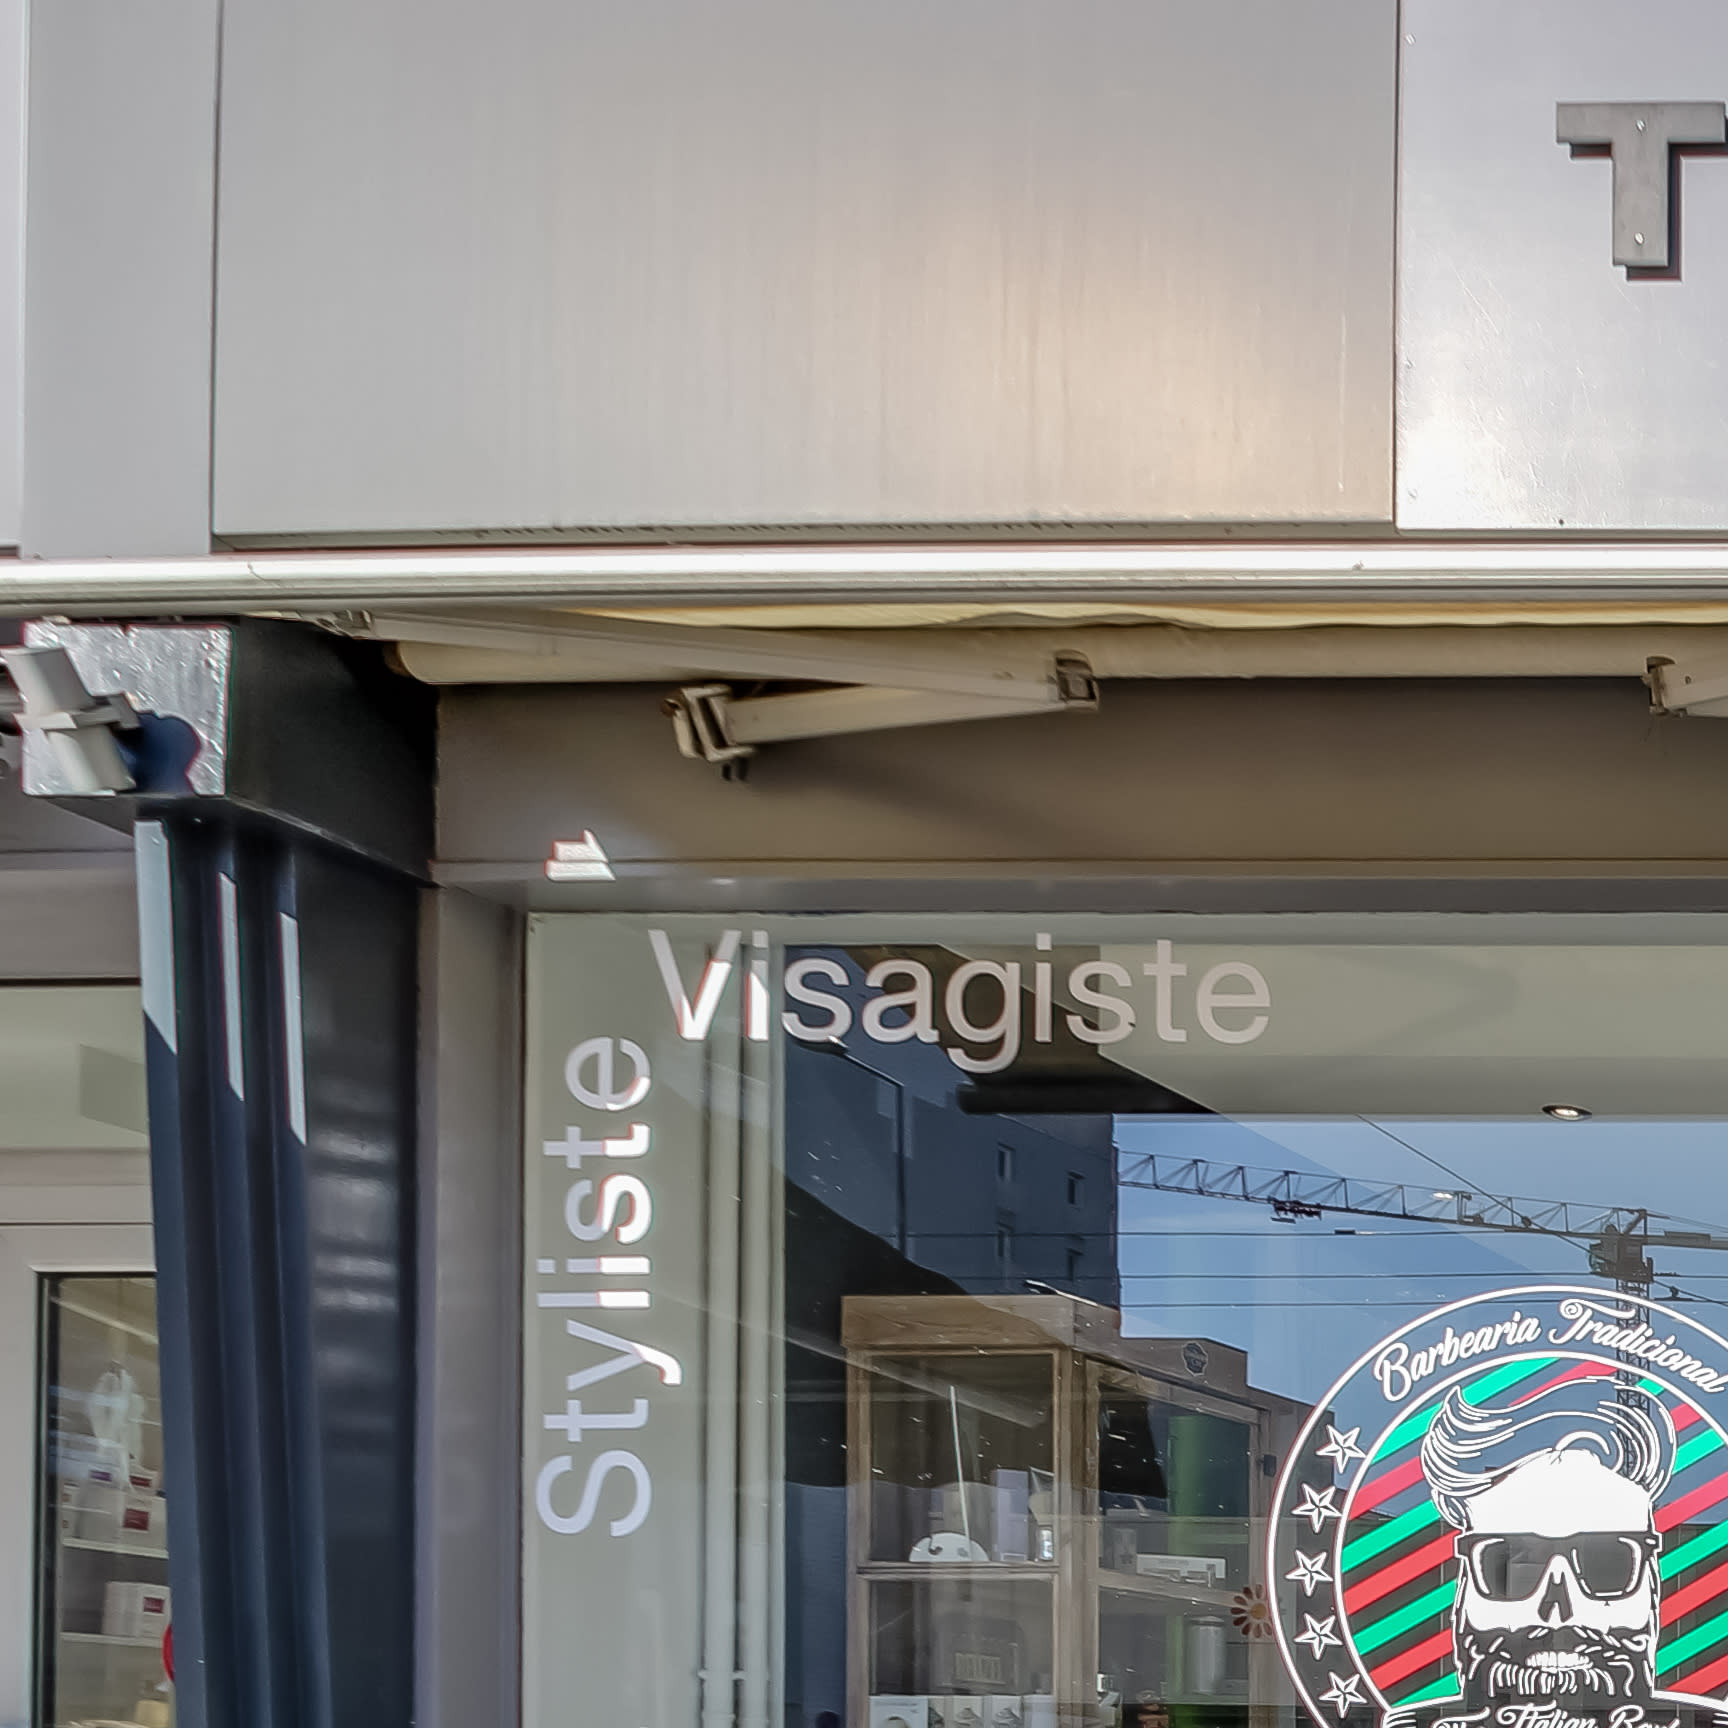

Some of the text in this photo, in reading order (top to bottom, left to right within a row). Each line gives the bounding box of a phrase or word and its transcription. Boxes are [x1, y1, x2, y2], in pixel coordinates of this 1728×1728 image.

[648, 929, 1271, 1074] Visagiste
[535, 1036, 684, 1538] Styliste
[1373, 1311, 1541, 1401] Barbearia
